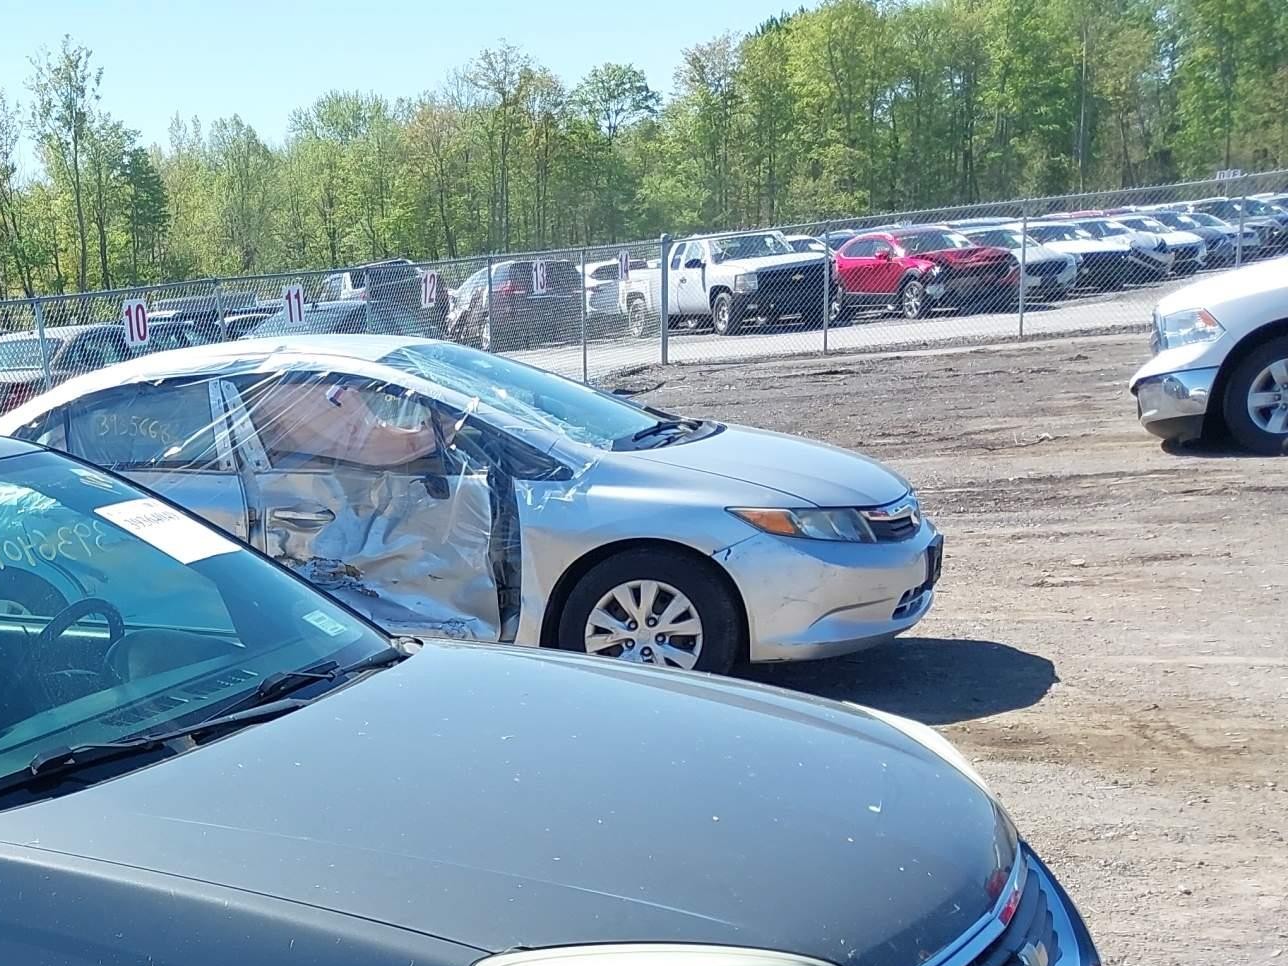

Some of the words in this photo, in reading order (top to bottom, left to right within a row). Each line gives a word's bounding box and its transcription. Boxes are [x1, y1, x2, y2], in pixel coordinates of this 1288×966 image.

[422, 274, 437, 303] 12
[534, 262, 546, 290] 13
[285, 288, 304, 323] 11
[124, 303, 148, 342] 10
